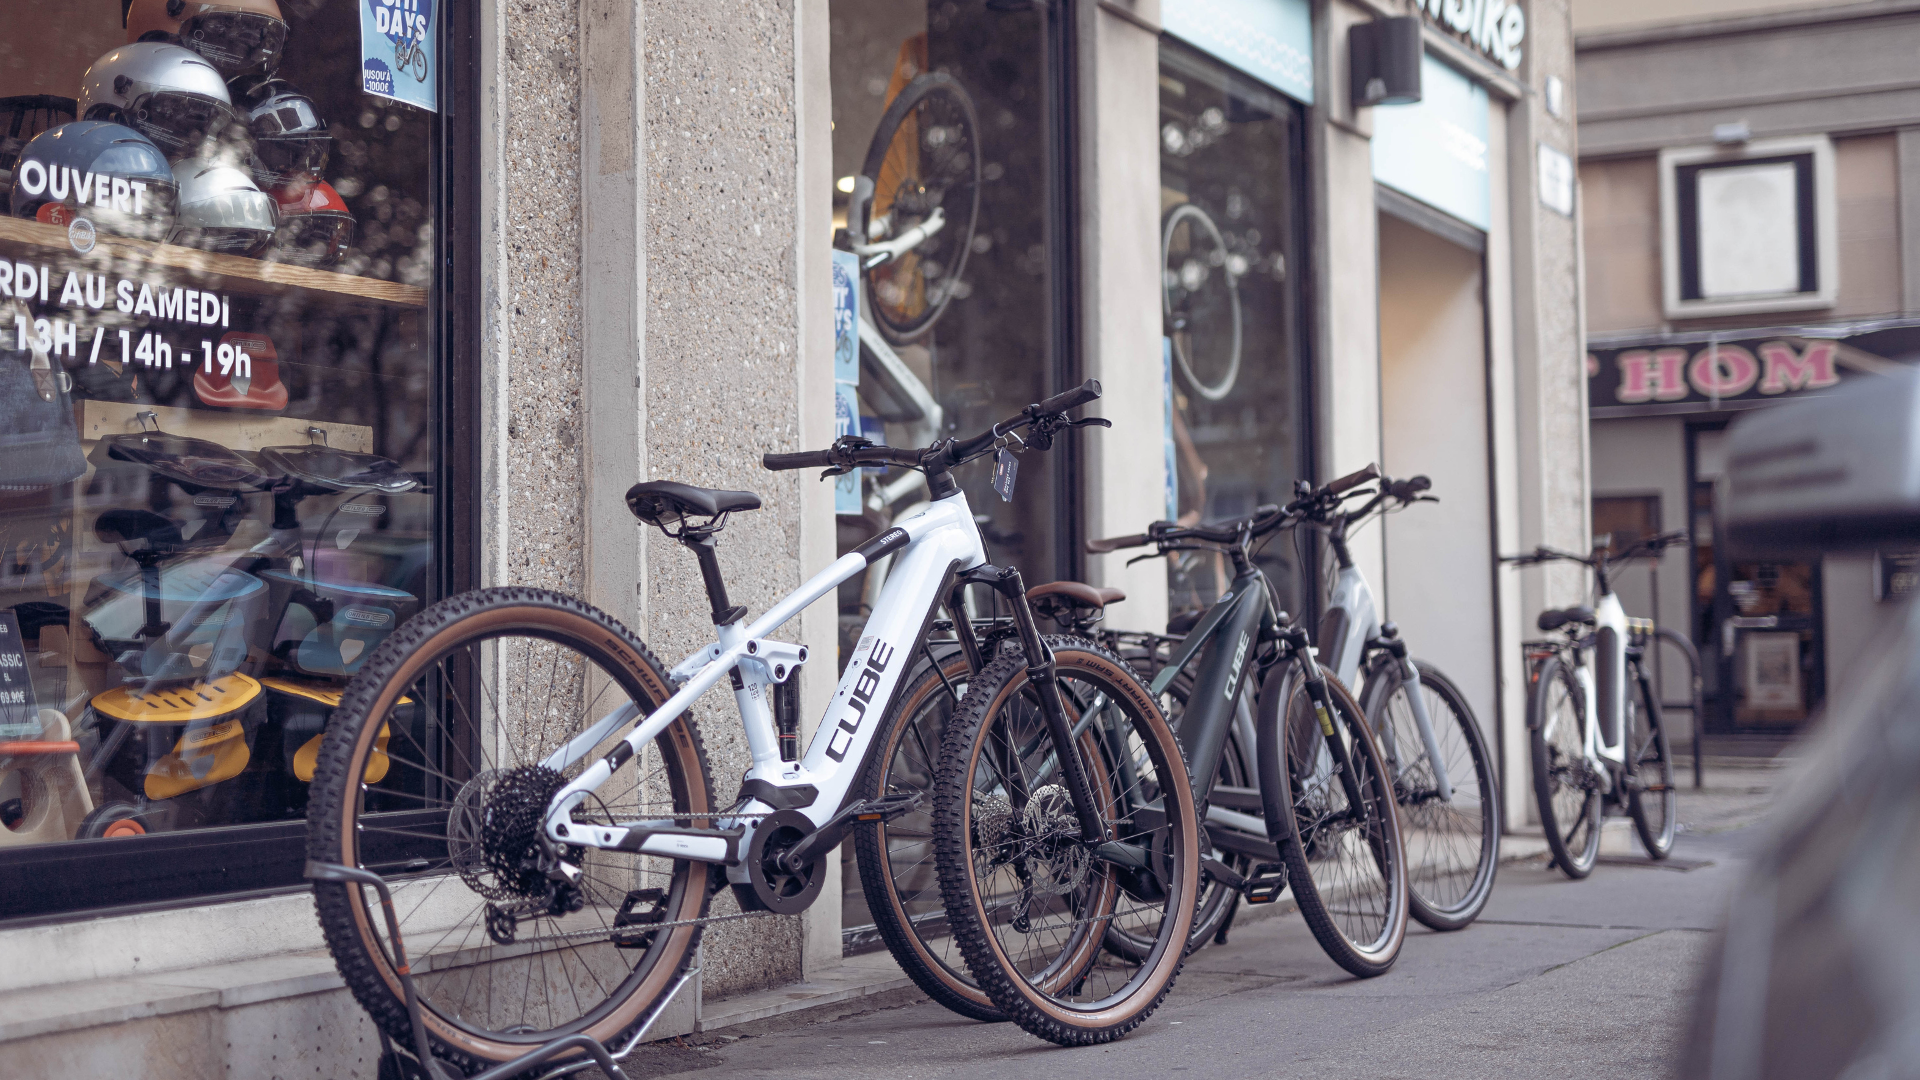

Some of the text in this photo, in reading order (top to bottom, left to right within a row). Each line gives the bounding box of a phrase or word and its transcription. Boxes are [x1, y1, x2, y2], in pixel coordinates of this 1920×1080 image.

[376, 6, 426, 41] DAYS
[364, 69, 391, 82] JUSQU'À
[366, 81, 389, 93] -1000€
[20, 160, 147, 214] OUVERT
[60, 271, 106, 309] AU
[117, 279, 229, 327] SAMEDI
[15, 315, 77, 357] 13H
[119, 330, 172, 368] 14h
[202, 341, 251, 378] 19h
[1615, 341, 1841, 403] HOM
[880, 529, 903, 545] STEREO
[604, 639, 689, 749] SCHWABE
[1086, 660, 1156, 720] SMART SAM
[1224, 630, 1250, 701] CUBE
[825, 638, 894, 764] CUBE
